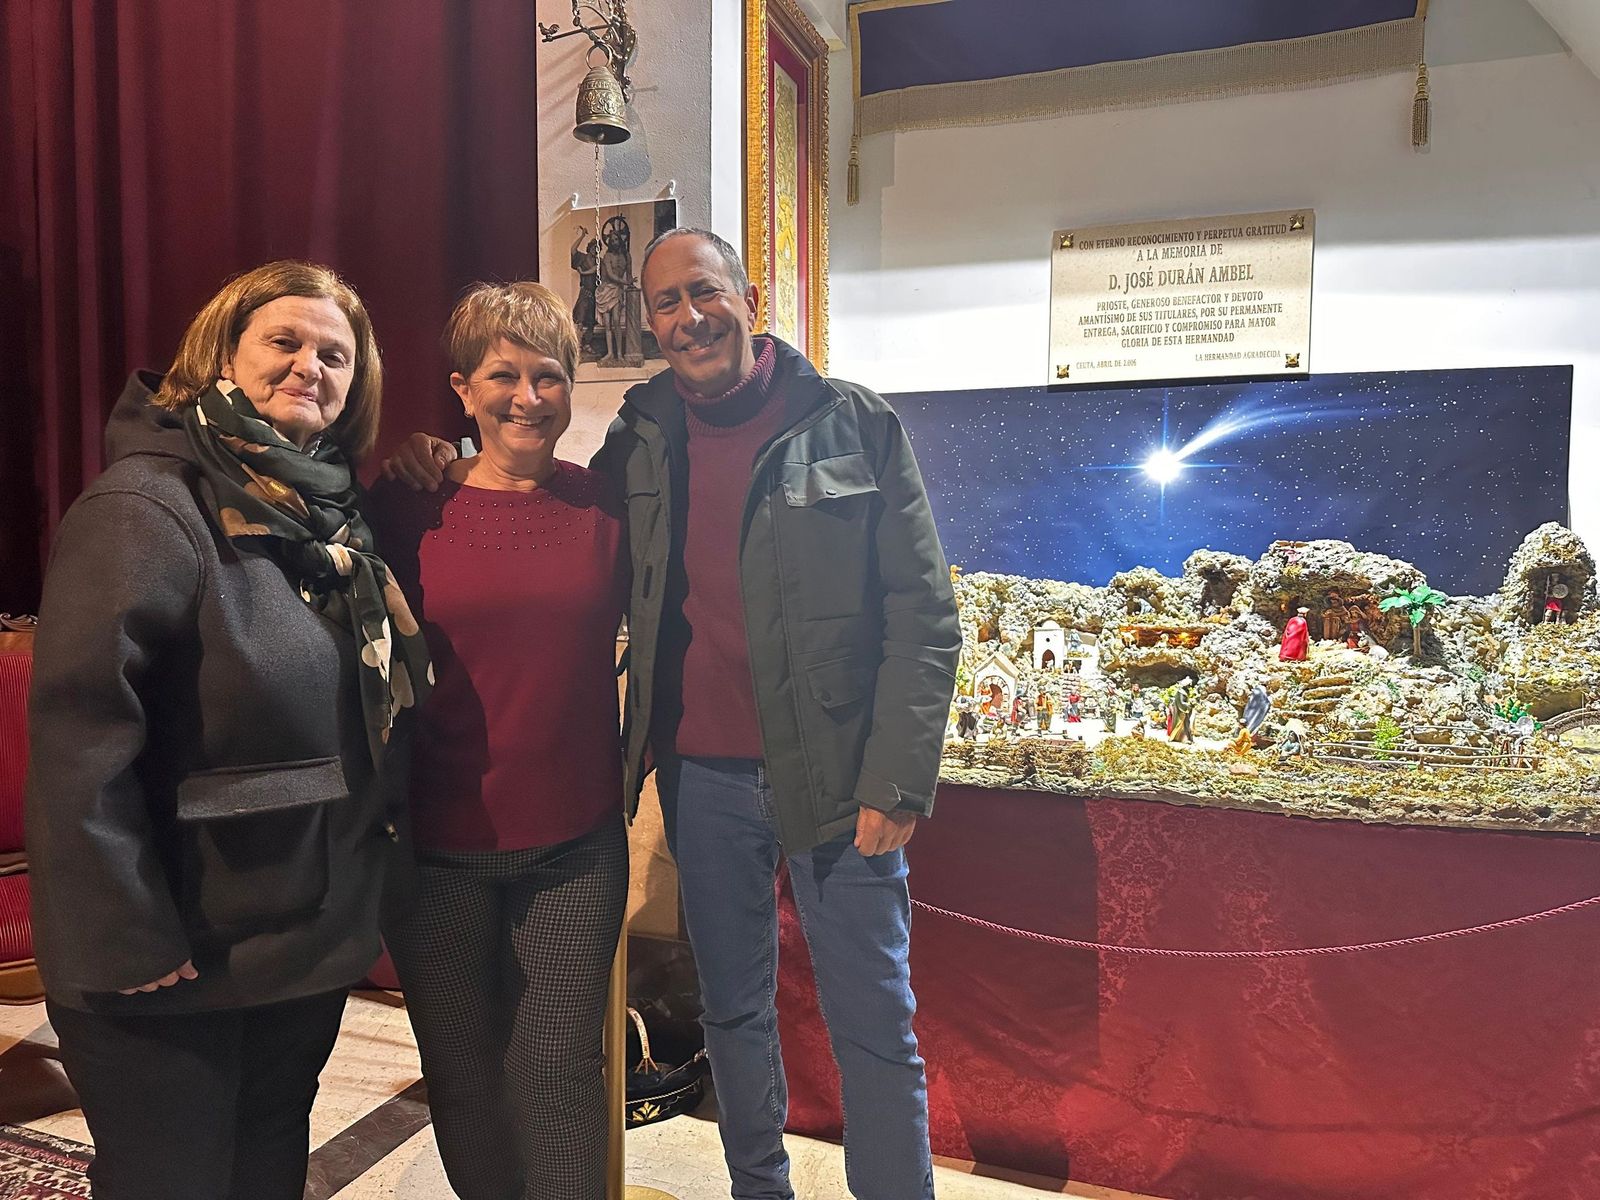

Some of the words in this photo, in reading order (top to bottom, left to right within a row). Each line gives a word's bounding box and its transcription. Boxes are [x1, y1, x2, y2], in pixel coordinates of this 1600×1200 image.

[1079, 240, 1094, 250] CON
[1096, 237, 1125, 249] ETERNO
[1127, 231, 1194, 247] RECONOCIMIENTO
[1196, 231, 1202, 240] Y
[1204, 228, 1243, 240] PERPETUA
[1246, 224, 1287, 236] GRATITUD
[1136, 249, 1143, 262] A
[1147, 248, 1159, 260] LA
[1161, 244, 1207, 260] MEMORIA
[1210, 243, 1223, 255] DE
[1109, 274, 1121, 290] D.
[1123, 265, 1154, 295] JOSÉ
[1158, 262, 1205, 286] DURÁN
[1209, 264, 1254, 283] AMBEL
[1097, 300, 1129, 311] PRIOSTE,
[1131, 297, 1170, 309] GENEROSO
[1172, 293, 1222, 306] BENEFACTOR
[1224, 293, 1229, 303] Y
[1231, 290, 1264, 302] DEVOTO
[1126, 312, 1137, 322] DE
[1139, 311, 1153, 321] SUS
[1200, 307, 1216, 317] POR
[1218, 306, 1228, 316] SU
[1230, 303, 1283, 316] PERMANENTE
[1083, 327, 1119, 338] ENTREGA,
[1120, 323, 1163, 336] SACRIFICIO
[1165, 323, 1170, 333] Y
[1172, 320, 1223, 333] COMPROMISO
[1224, 318, 1246, 329] PARA
[1248, 317, 1276, 328] MAYOR
[1121, 338, 1149, 348] GLORIA
[1151, 336, 1162, 346] DE
[1164, 335, 1182, 346] ESTA
[1185, 332, 1235, 345] HERMANDAD
